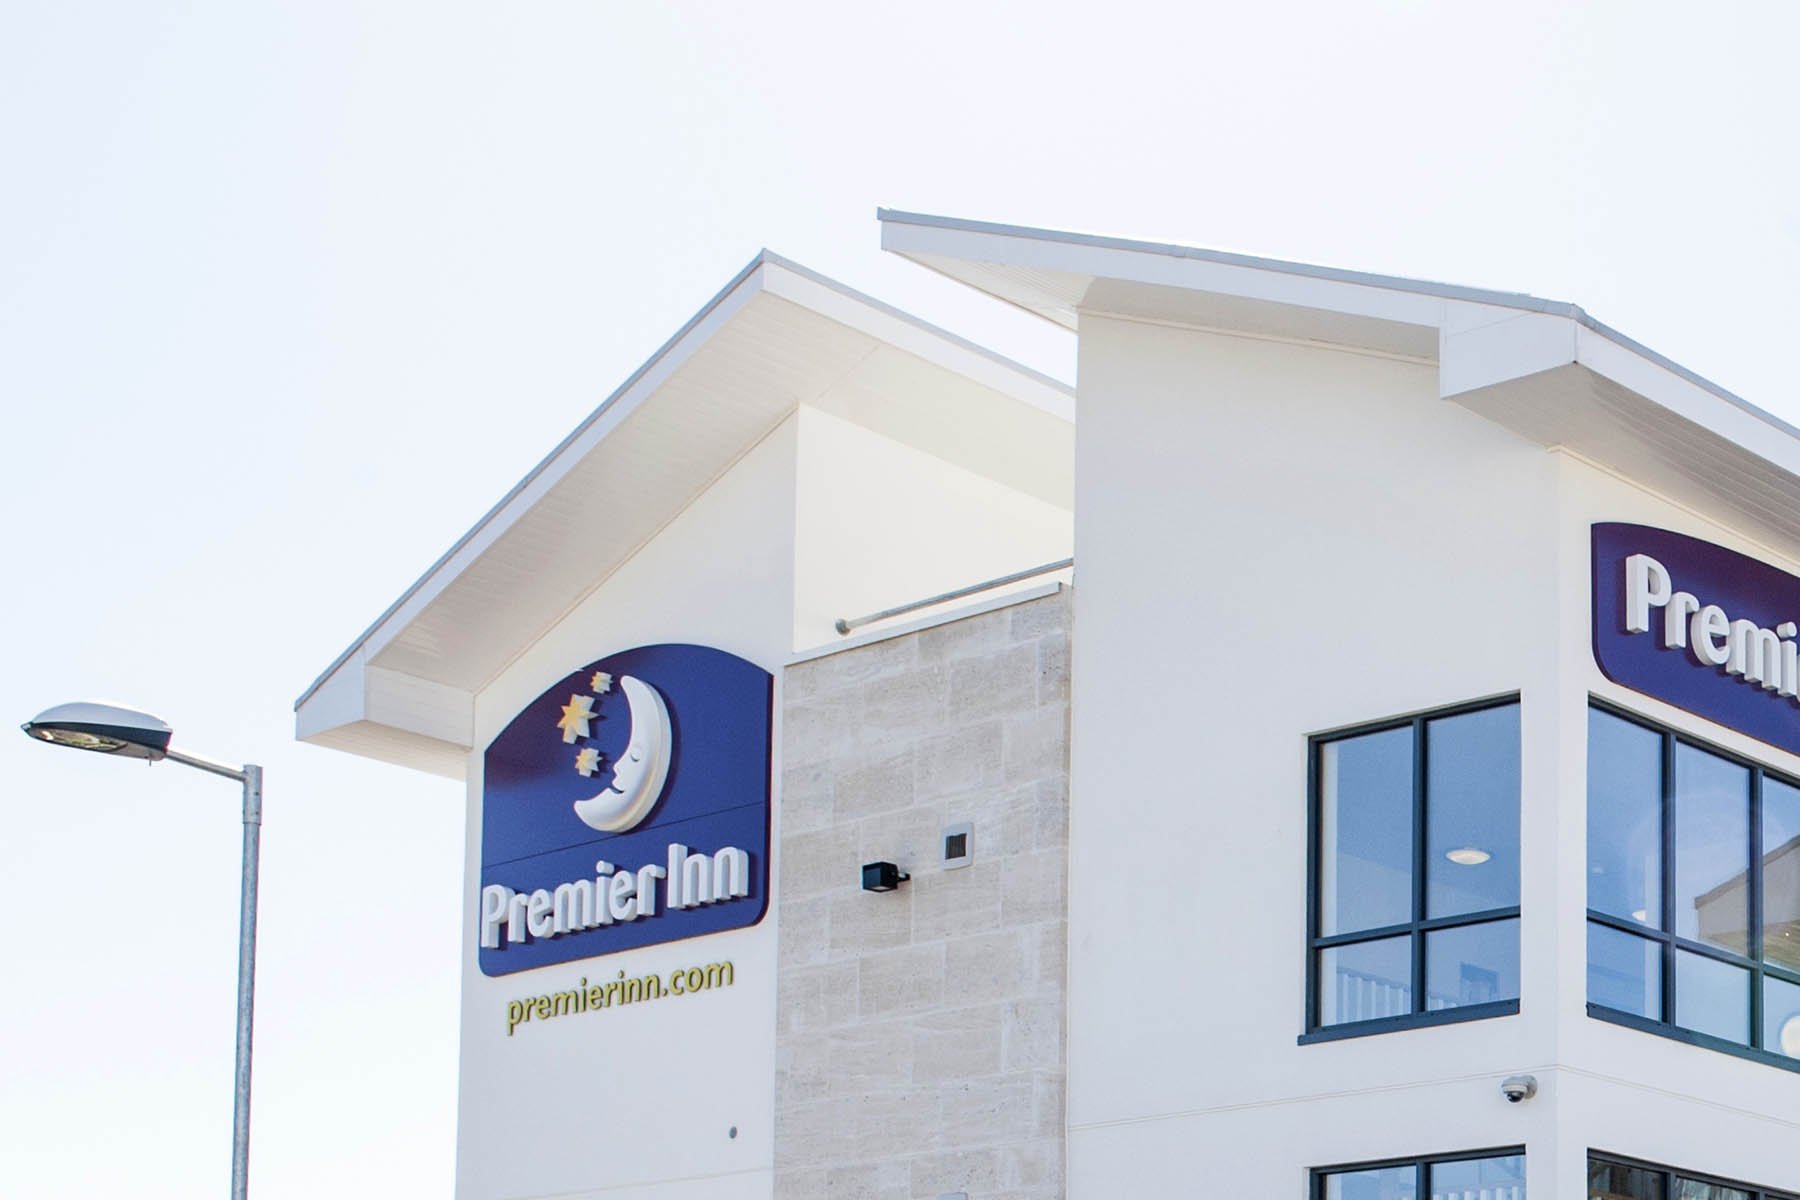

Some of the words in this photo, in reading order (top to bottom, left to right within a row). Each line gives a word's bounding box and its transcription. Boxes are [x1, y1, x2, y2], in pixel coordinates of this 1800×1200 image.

[481, 860, 667, 949] Premier
[667, 843, 749, 909] Inn
[507, 960, 734, 1036] premierinn.com
